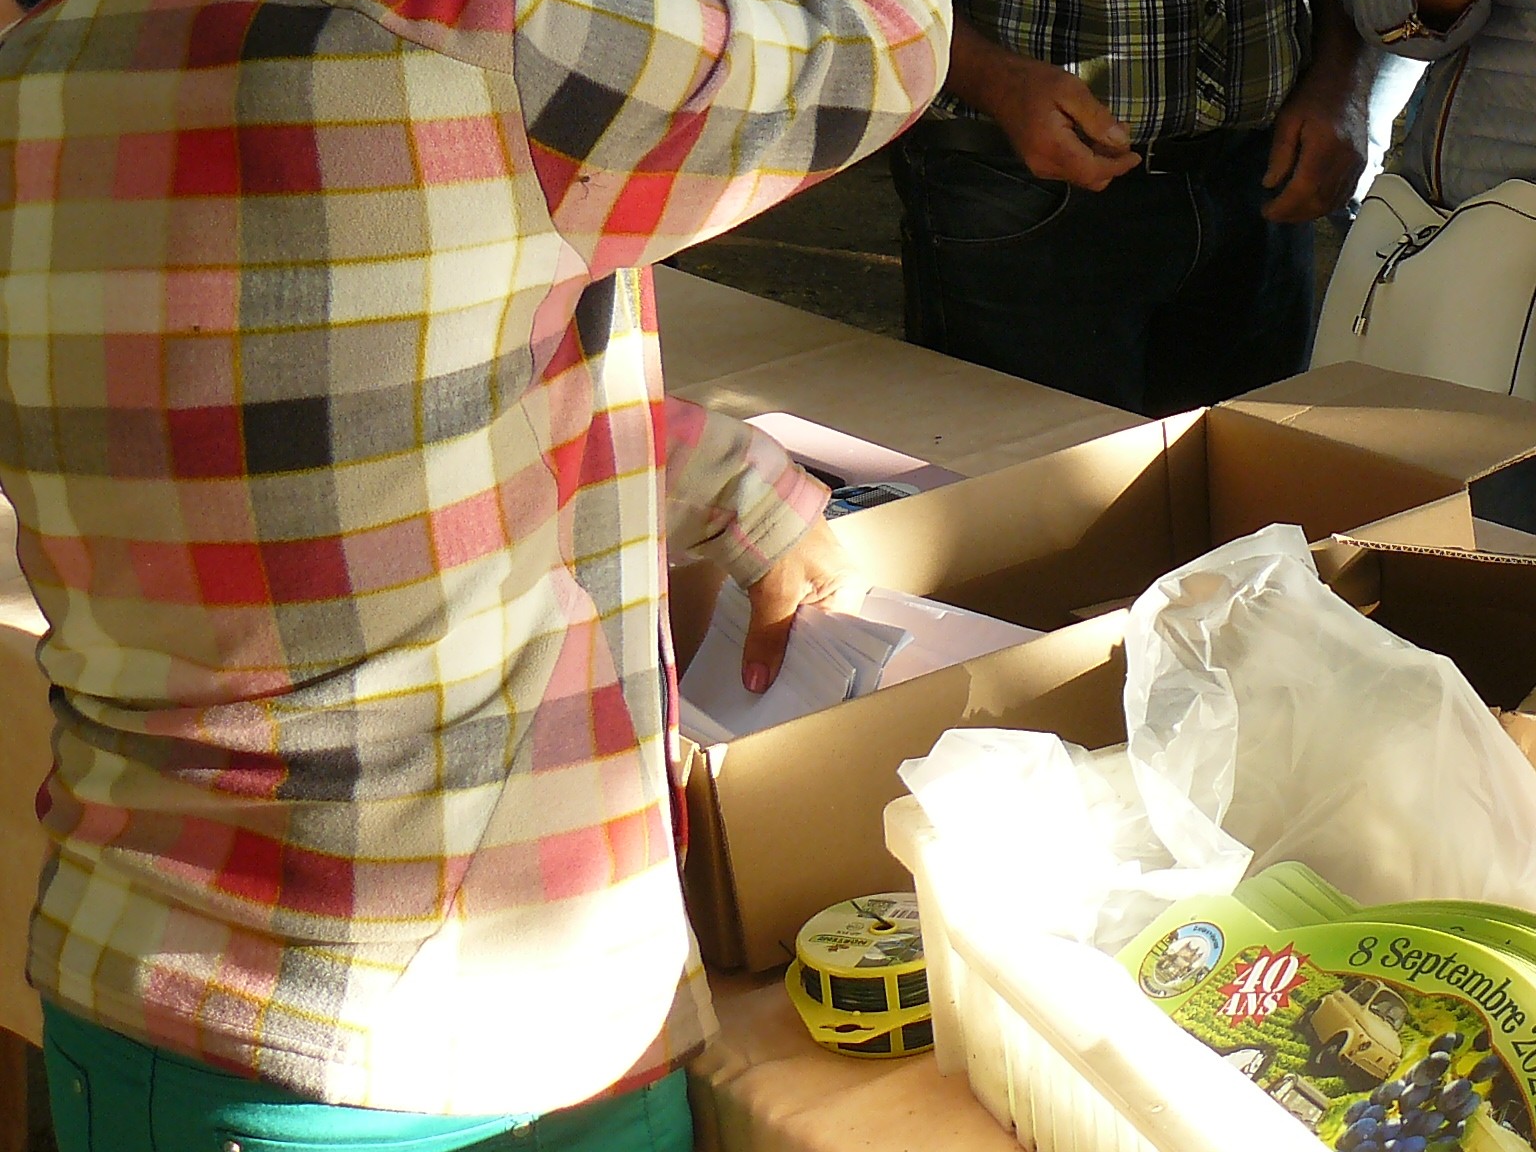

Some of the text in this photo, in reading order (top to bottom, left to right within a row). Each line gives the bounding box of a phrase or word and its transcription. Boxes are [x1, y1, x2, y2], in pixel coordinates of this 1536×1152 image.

[1233, 955, 1299, 993] 40
[1348, 936, 1378, 967] 8
[1381, 937, 1526, 1034] Septembre
[1216, 992, 1283, 1016] ANS
